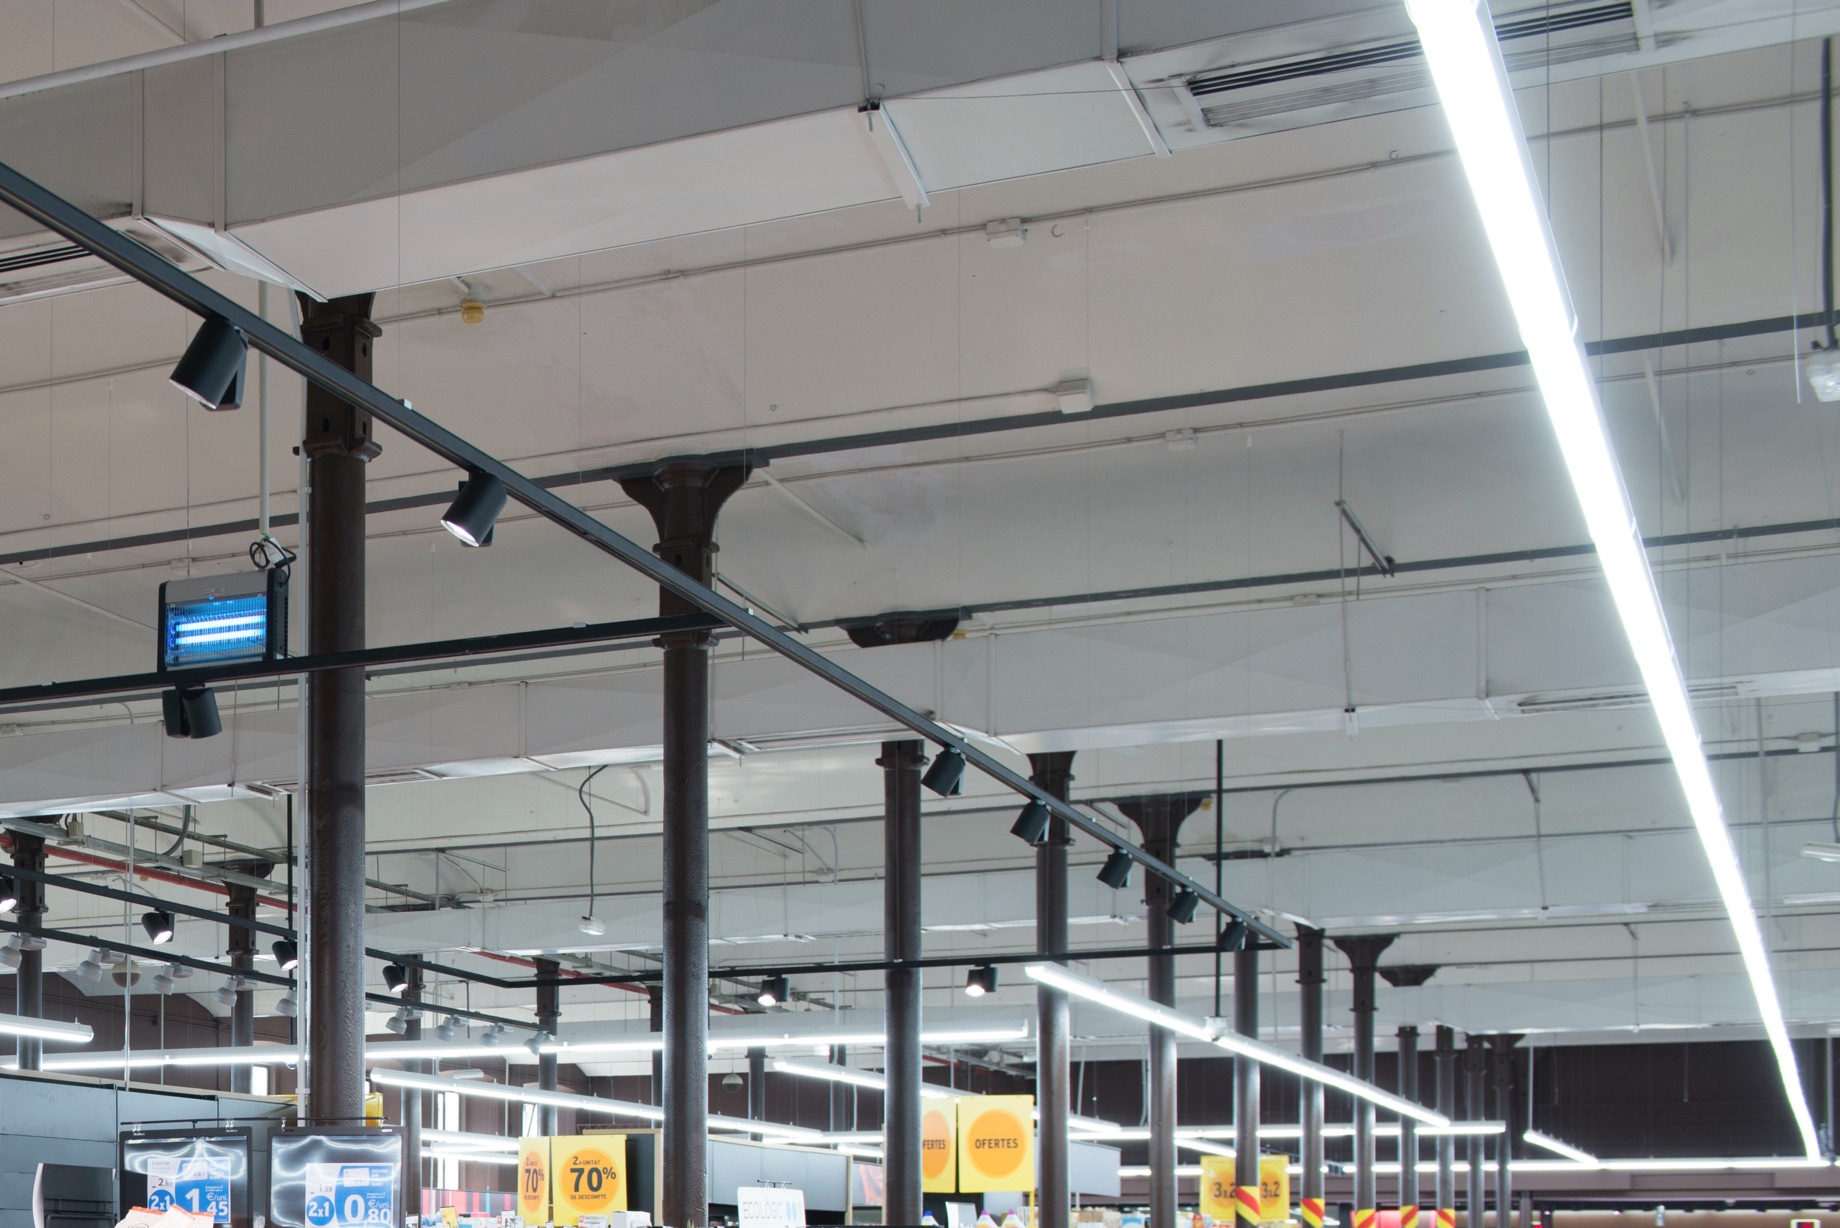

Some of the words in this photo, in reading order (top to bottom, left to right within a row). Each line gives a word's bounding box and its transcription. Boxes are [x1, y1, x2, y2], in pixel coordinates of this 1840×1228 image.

[974, 1138, 1019, 1149] OFERTES
[524, 1168, 545, 1194] 70%
[570, 1167, 617, 1193] 70%
[150, 1195, 170, 1211] 2x1
[308, 1201, 330, 1217] 2x1
